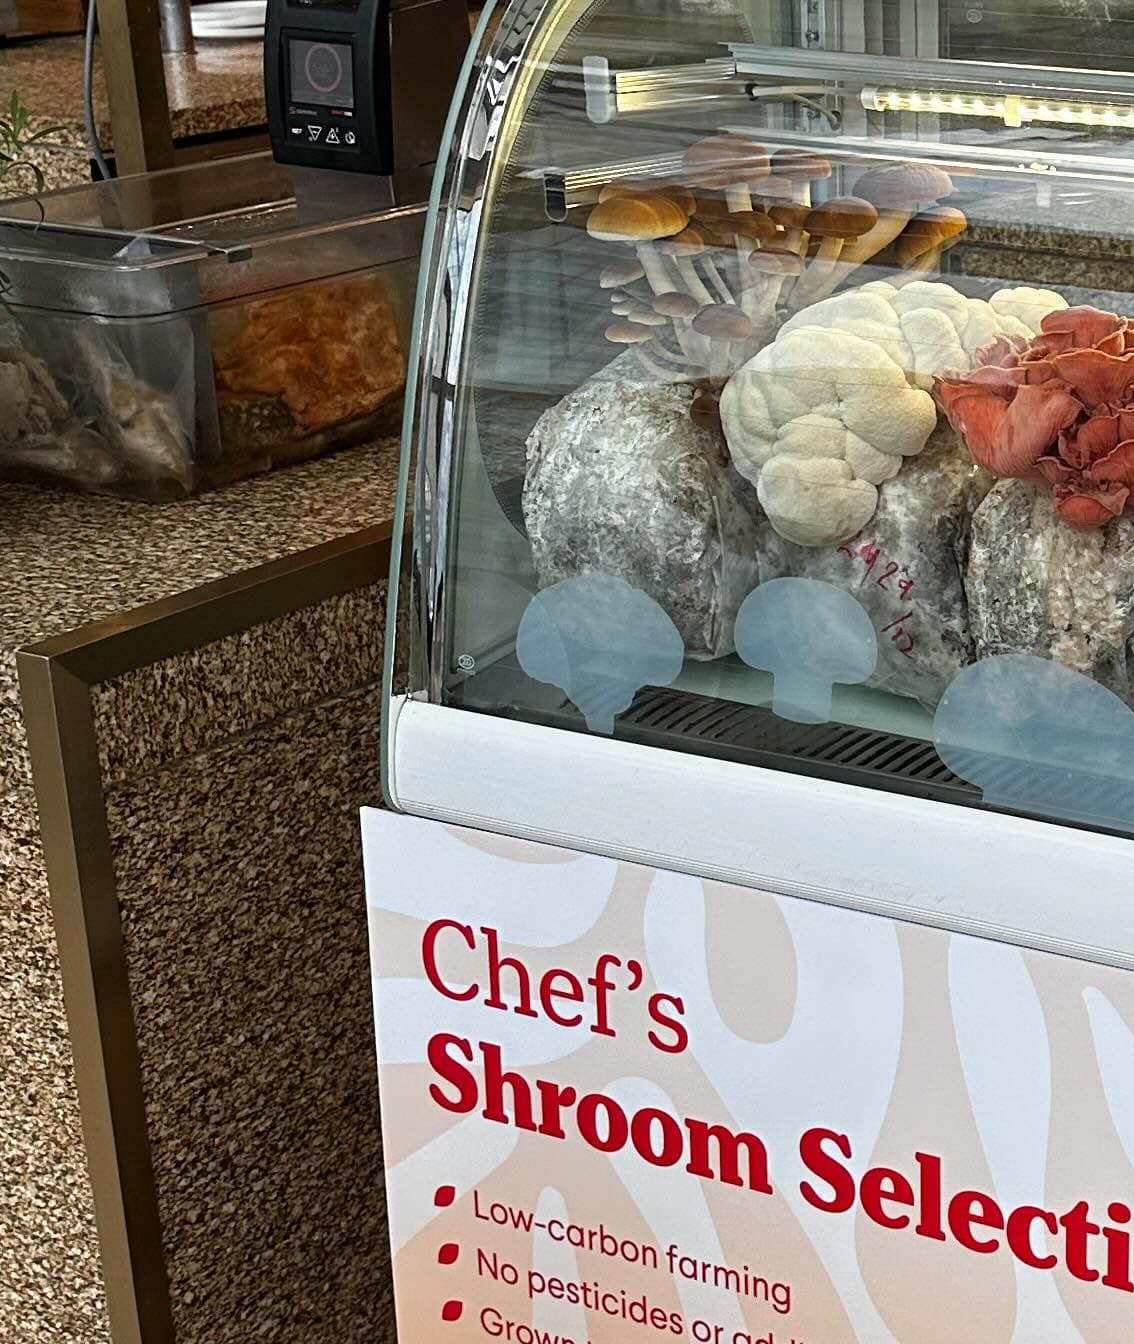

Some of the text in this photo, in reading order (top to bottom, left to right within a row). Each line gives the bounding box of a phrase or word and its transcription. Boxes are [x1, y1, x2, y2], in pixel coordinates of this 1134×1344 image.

[421, 919, 689, 1054] Chef’s
[427, 1032, 775, 1196] Shroom
[473, 1189, 792, 1315] Low-carbon farming
[476, 1248, 518, 1287] No
[528, 1265, 684, 1337] pesticides
[692, 1317, 724, 1344] or
